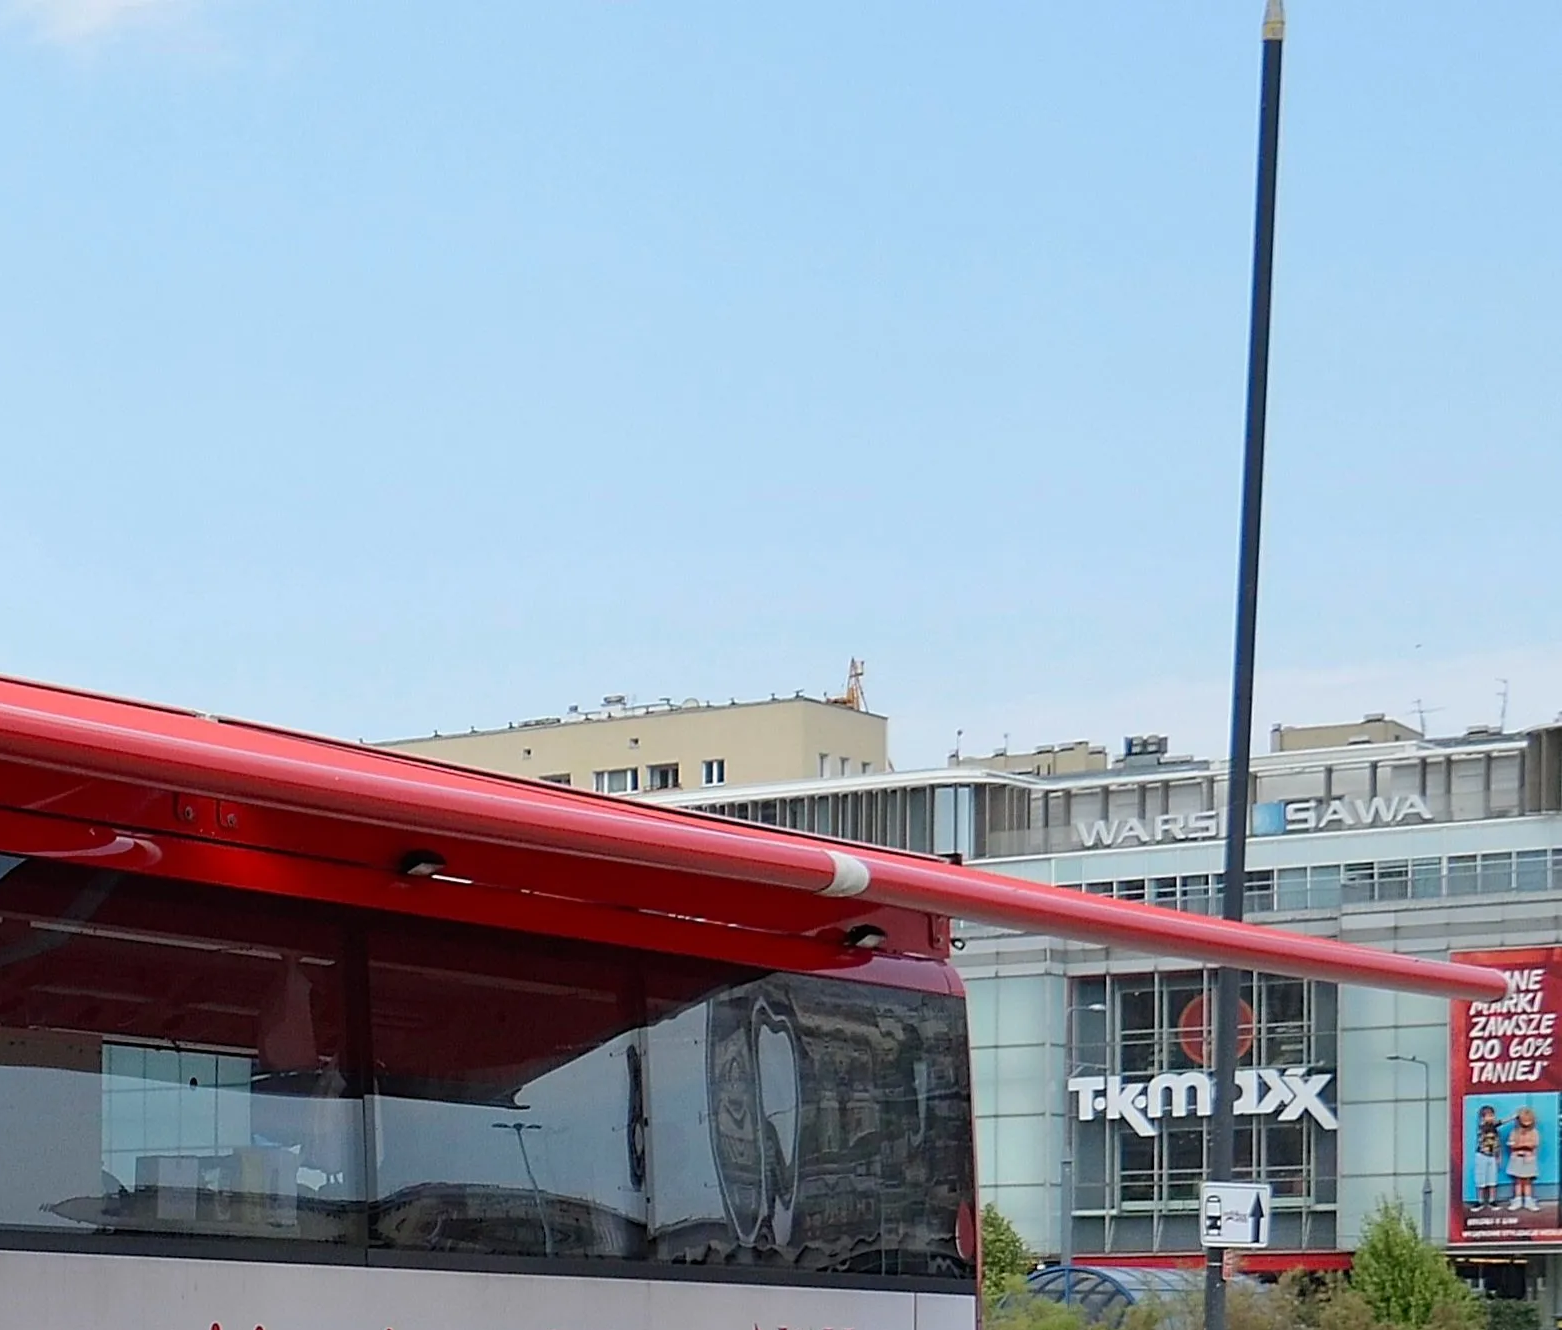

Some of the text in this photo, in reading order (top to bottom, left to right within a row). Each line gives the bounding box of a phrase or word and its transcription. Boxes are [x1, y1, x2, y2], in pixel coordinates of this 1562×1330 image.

[1076, 794, 1435, 848] WARS SAWA
[1469, 1013, 1557, 1038] ZAWSZE
[1468, 1037, 1554, 1060] DO 60%
